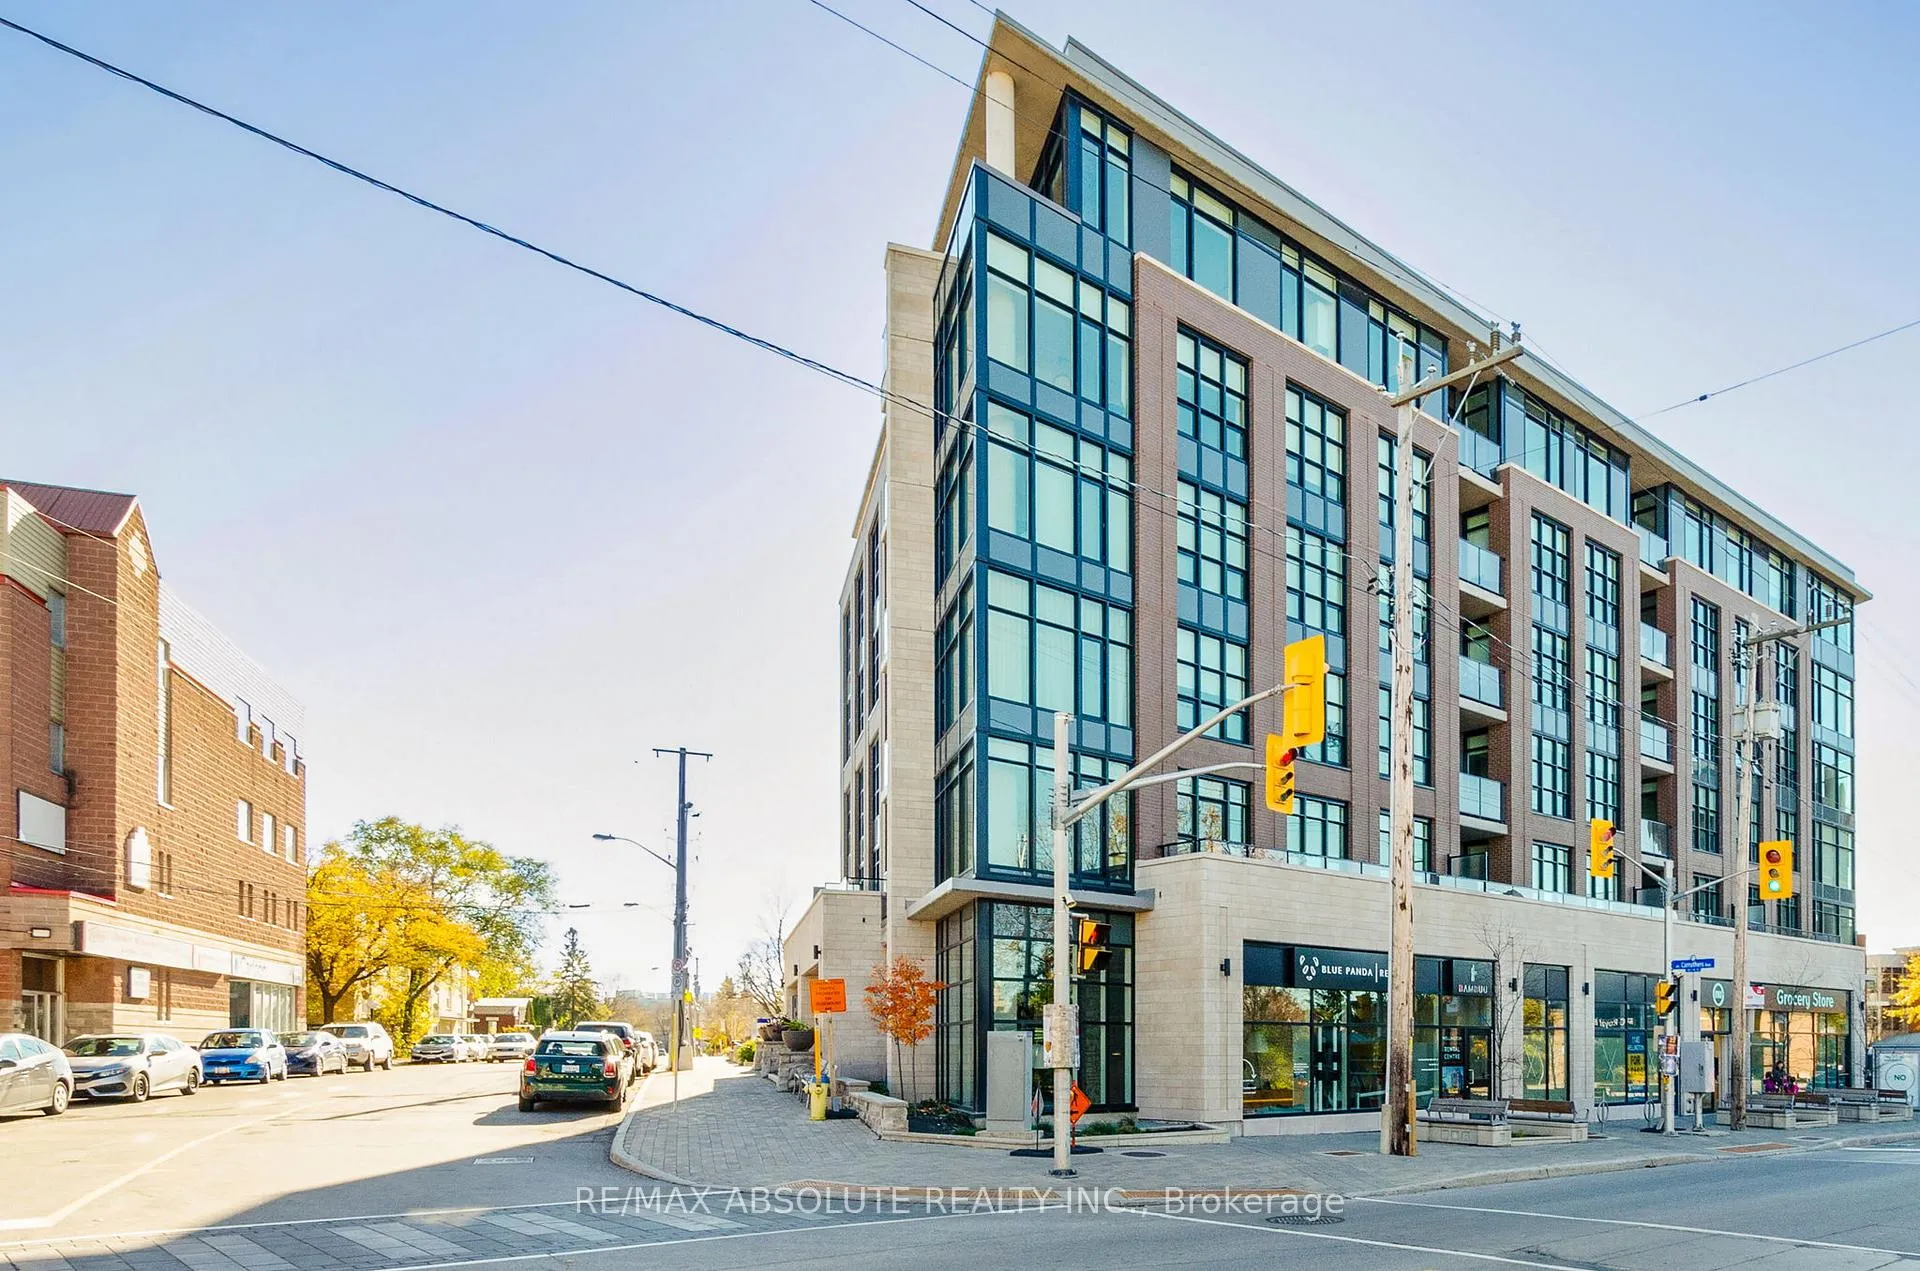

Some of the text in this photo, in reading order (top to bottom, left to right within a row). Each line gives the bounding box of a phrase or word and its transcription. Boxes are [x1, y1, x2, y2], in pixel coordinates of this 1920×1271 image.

[1321, 965, 1343, 975] BLUE
[1345, 967, 1374, 977] PANDA
[1776, 989, 1835, 1010] Grocery Store
